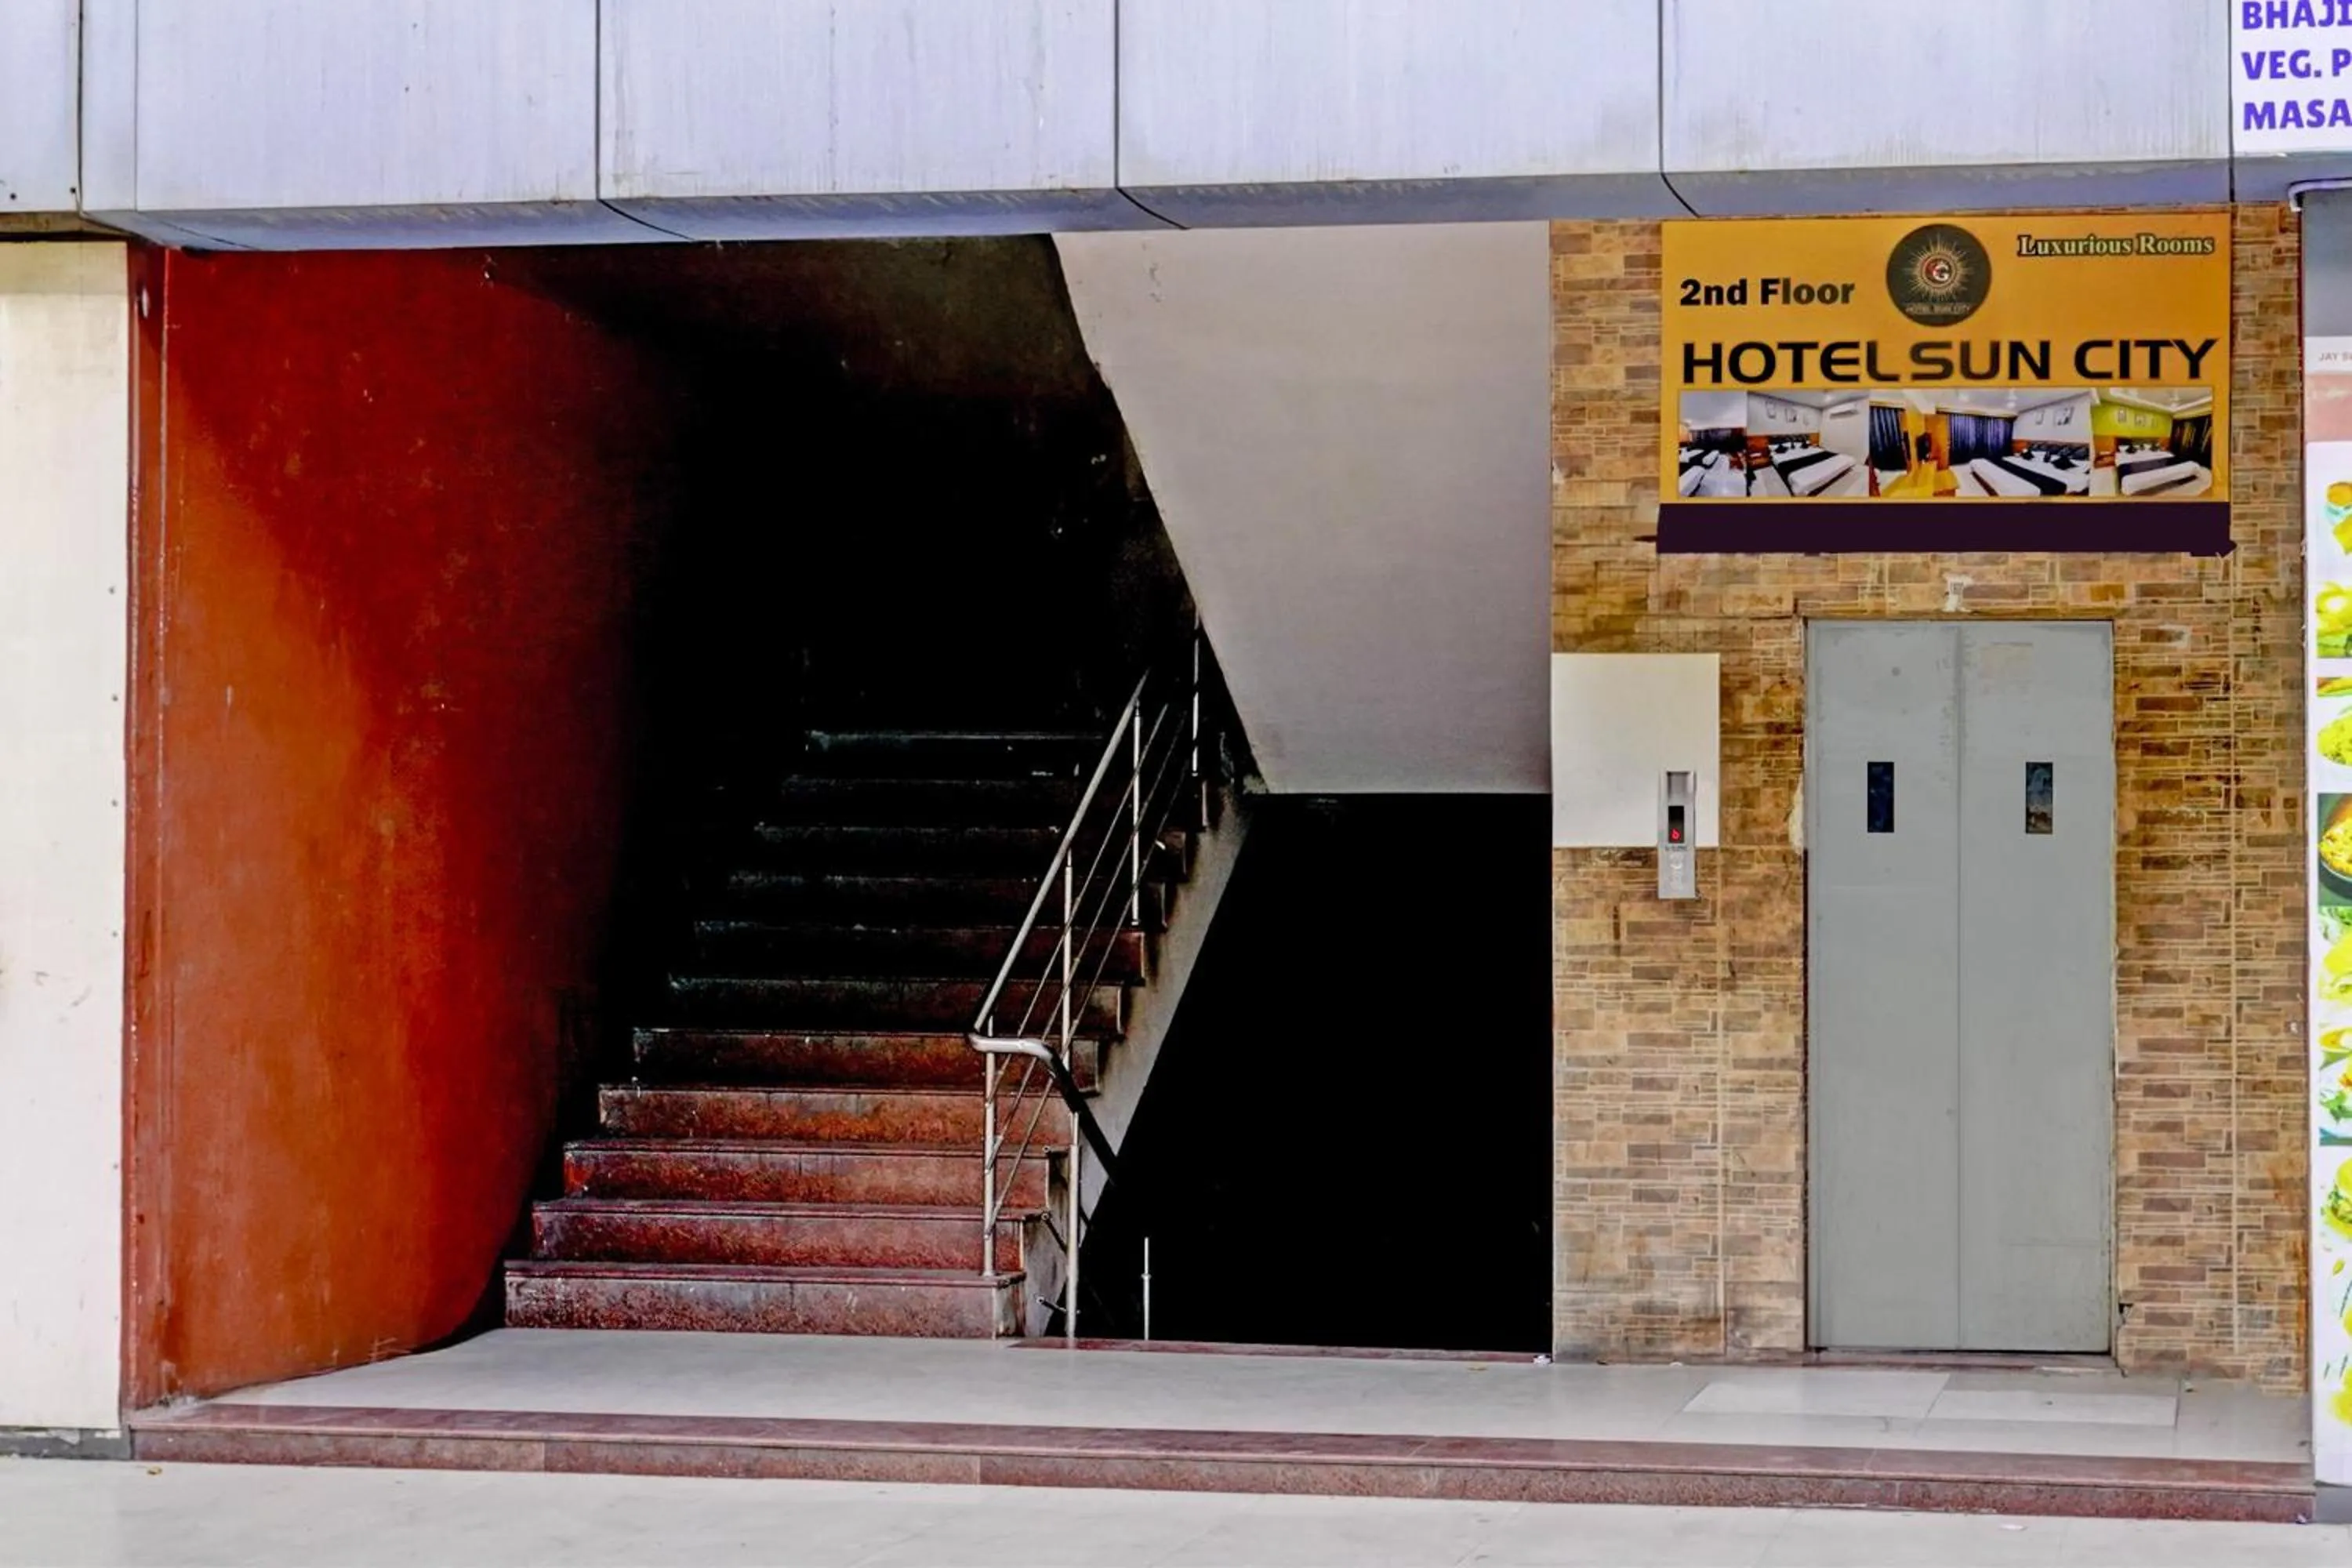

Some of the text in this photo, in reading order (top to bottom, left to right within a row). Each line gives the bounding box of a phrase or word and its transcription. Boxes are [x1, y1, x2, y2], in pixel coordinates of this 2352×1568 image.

[2241, 49, 2322, 80] VEG.
[2017, 234, 2215, 256] Luxurious Rooms
[1680, 278, 1855, 306] 2nd Floor
[1683, 338, 2220, 383] HOTEL SUN CITY
